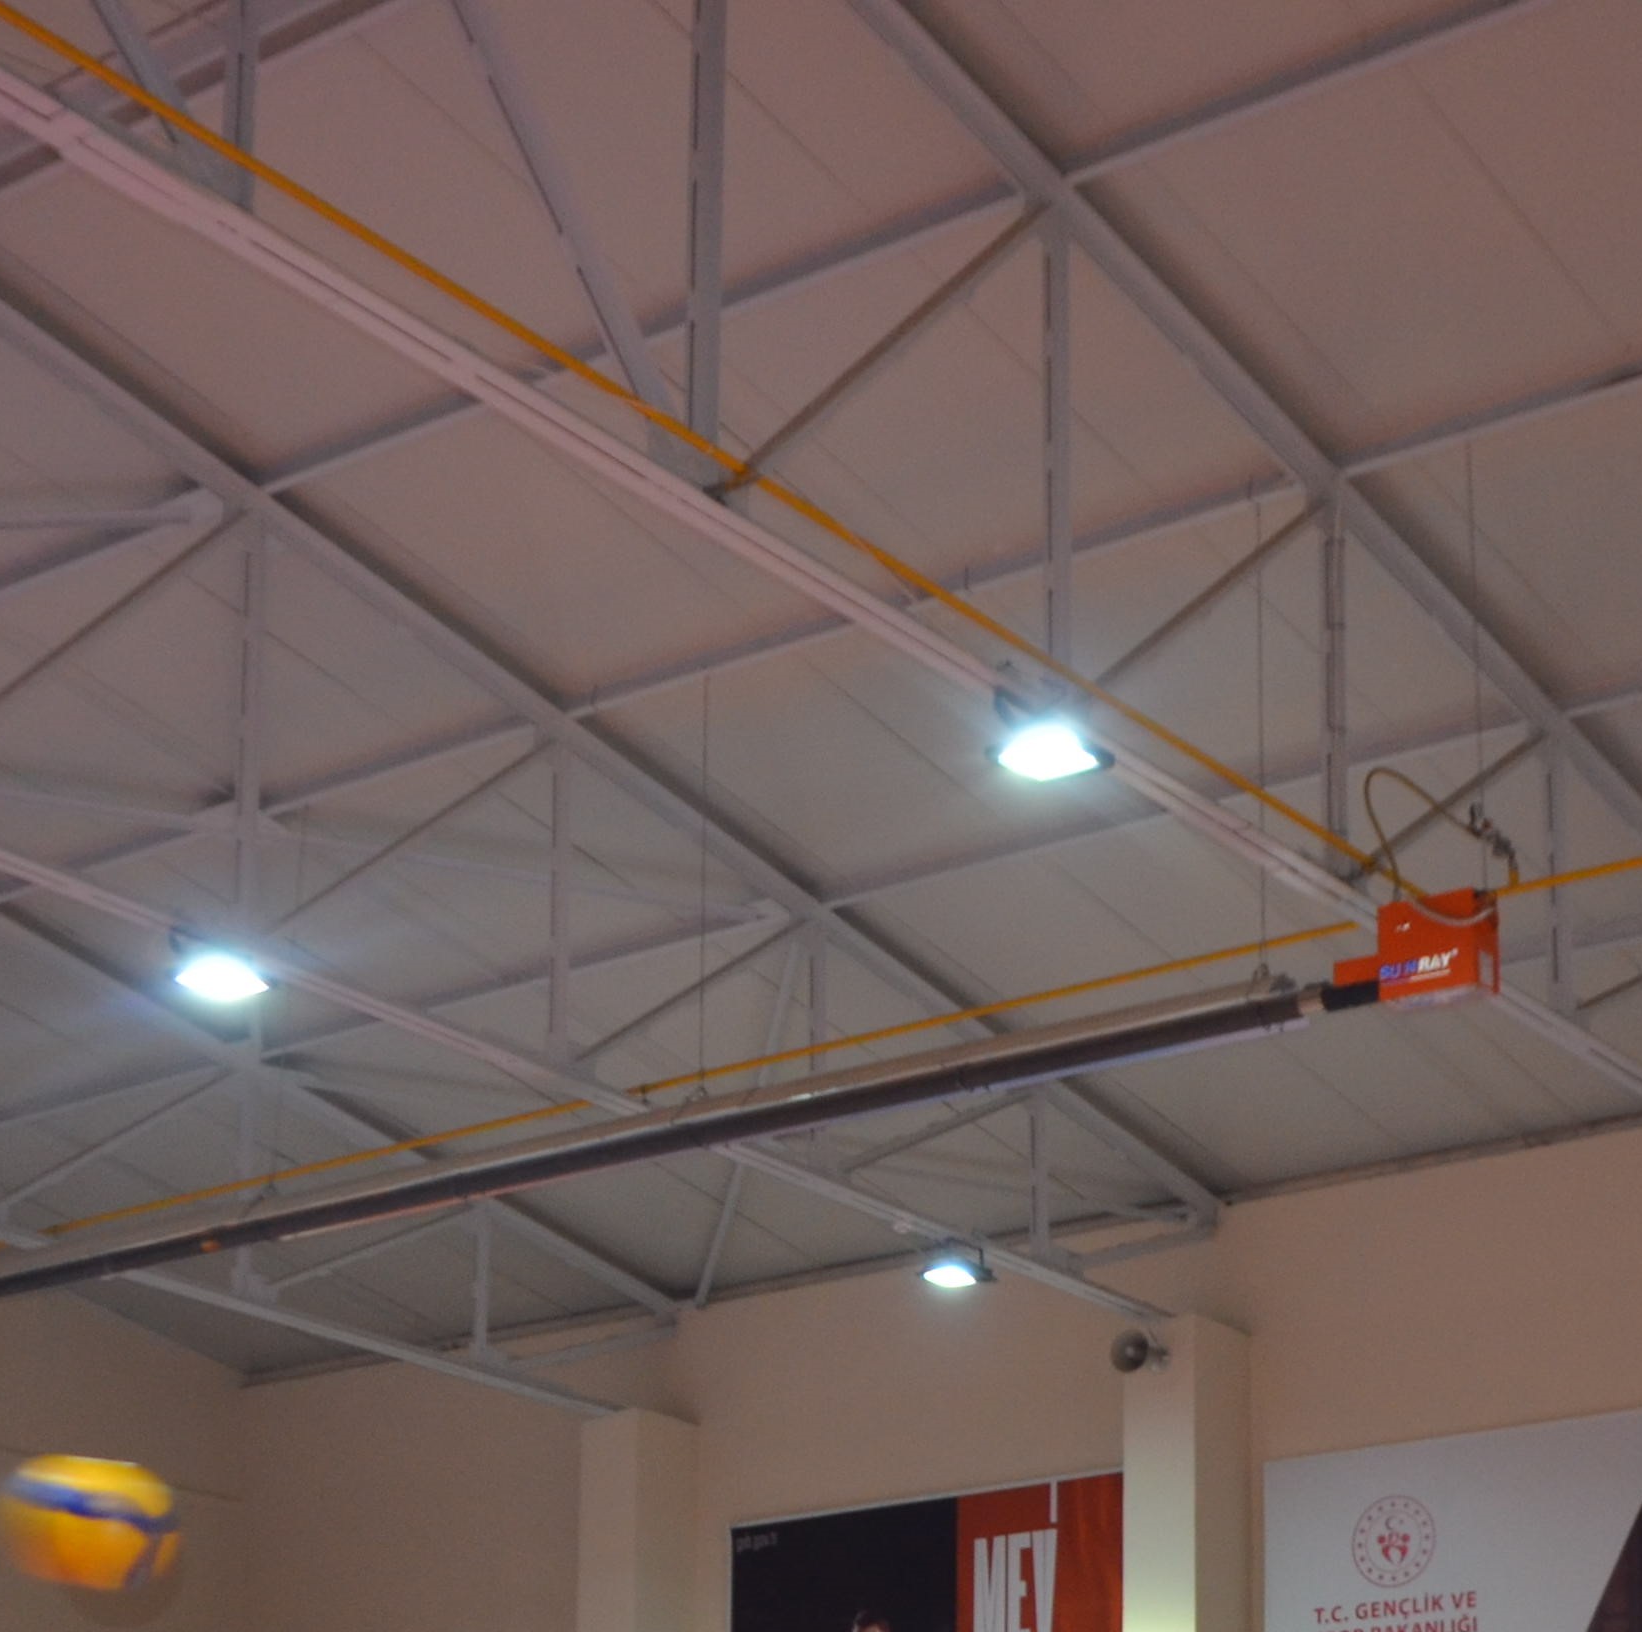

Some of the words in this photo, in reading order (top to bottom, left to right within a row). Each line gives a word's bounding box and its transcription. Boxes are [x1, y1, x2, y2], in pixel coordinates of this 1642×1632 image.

[1314, 1606, 1349, 1624] T.C.
[1355, 1592, 1444, 1620] GENÇLİK
[1451, 1591, 1477, 1609] VE
